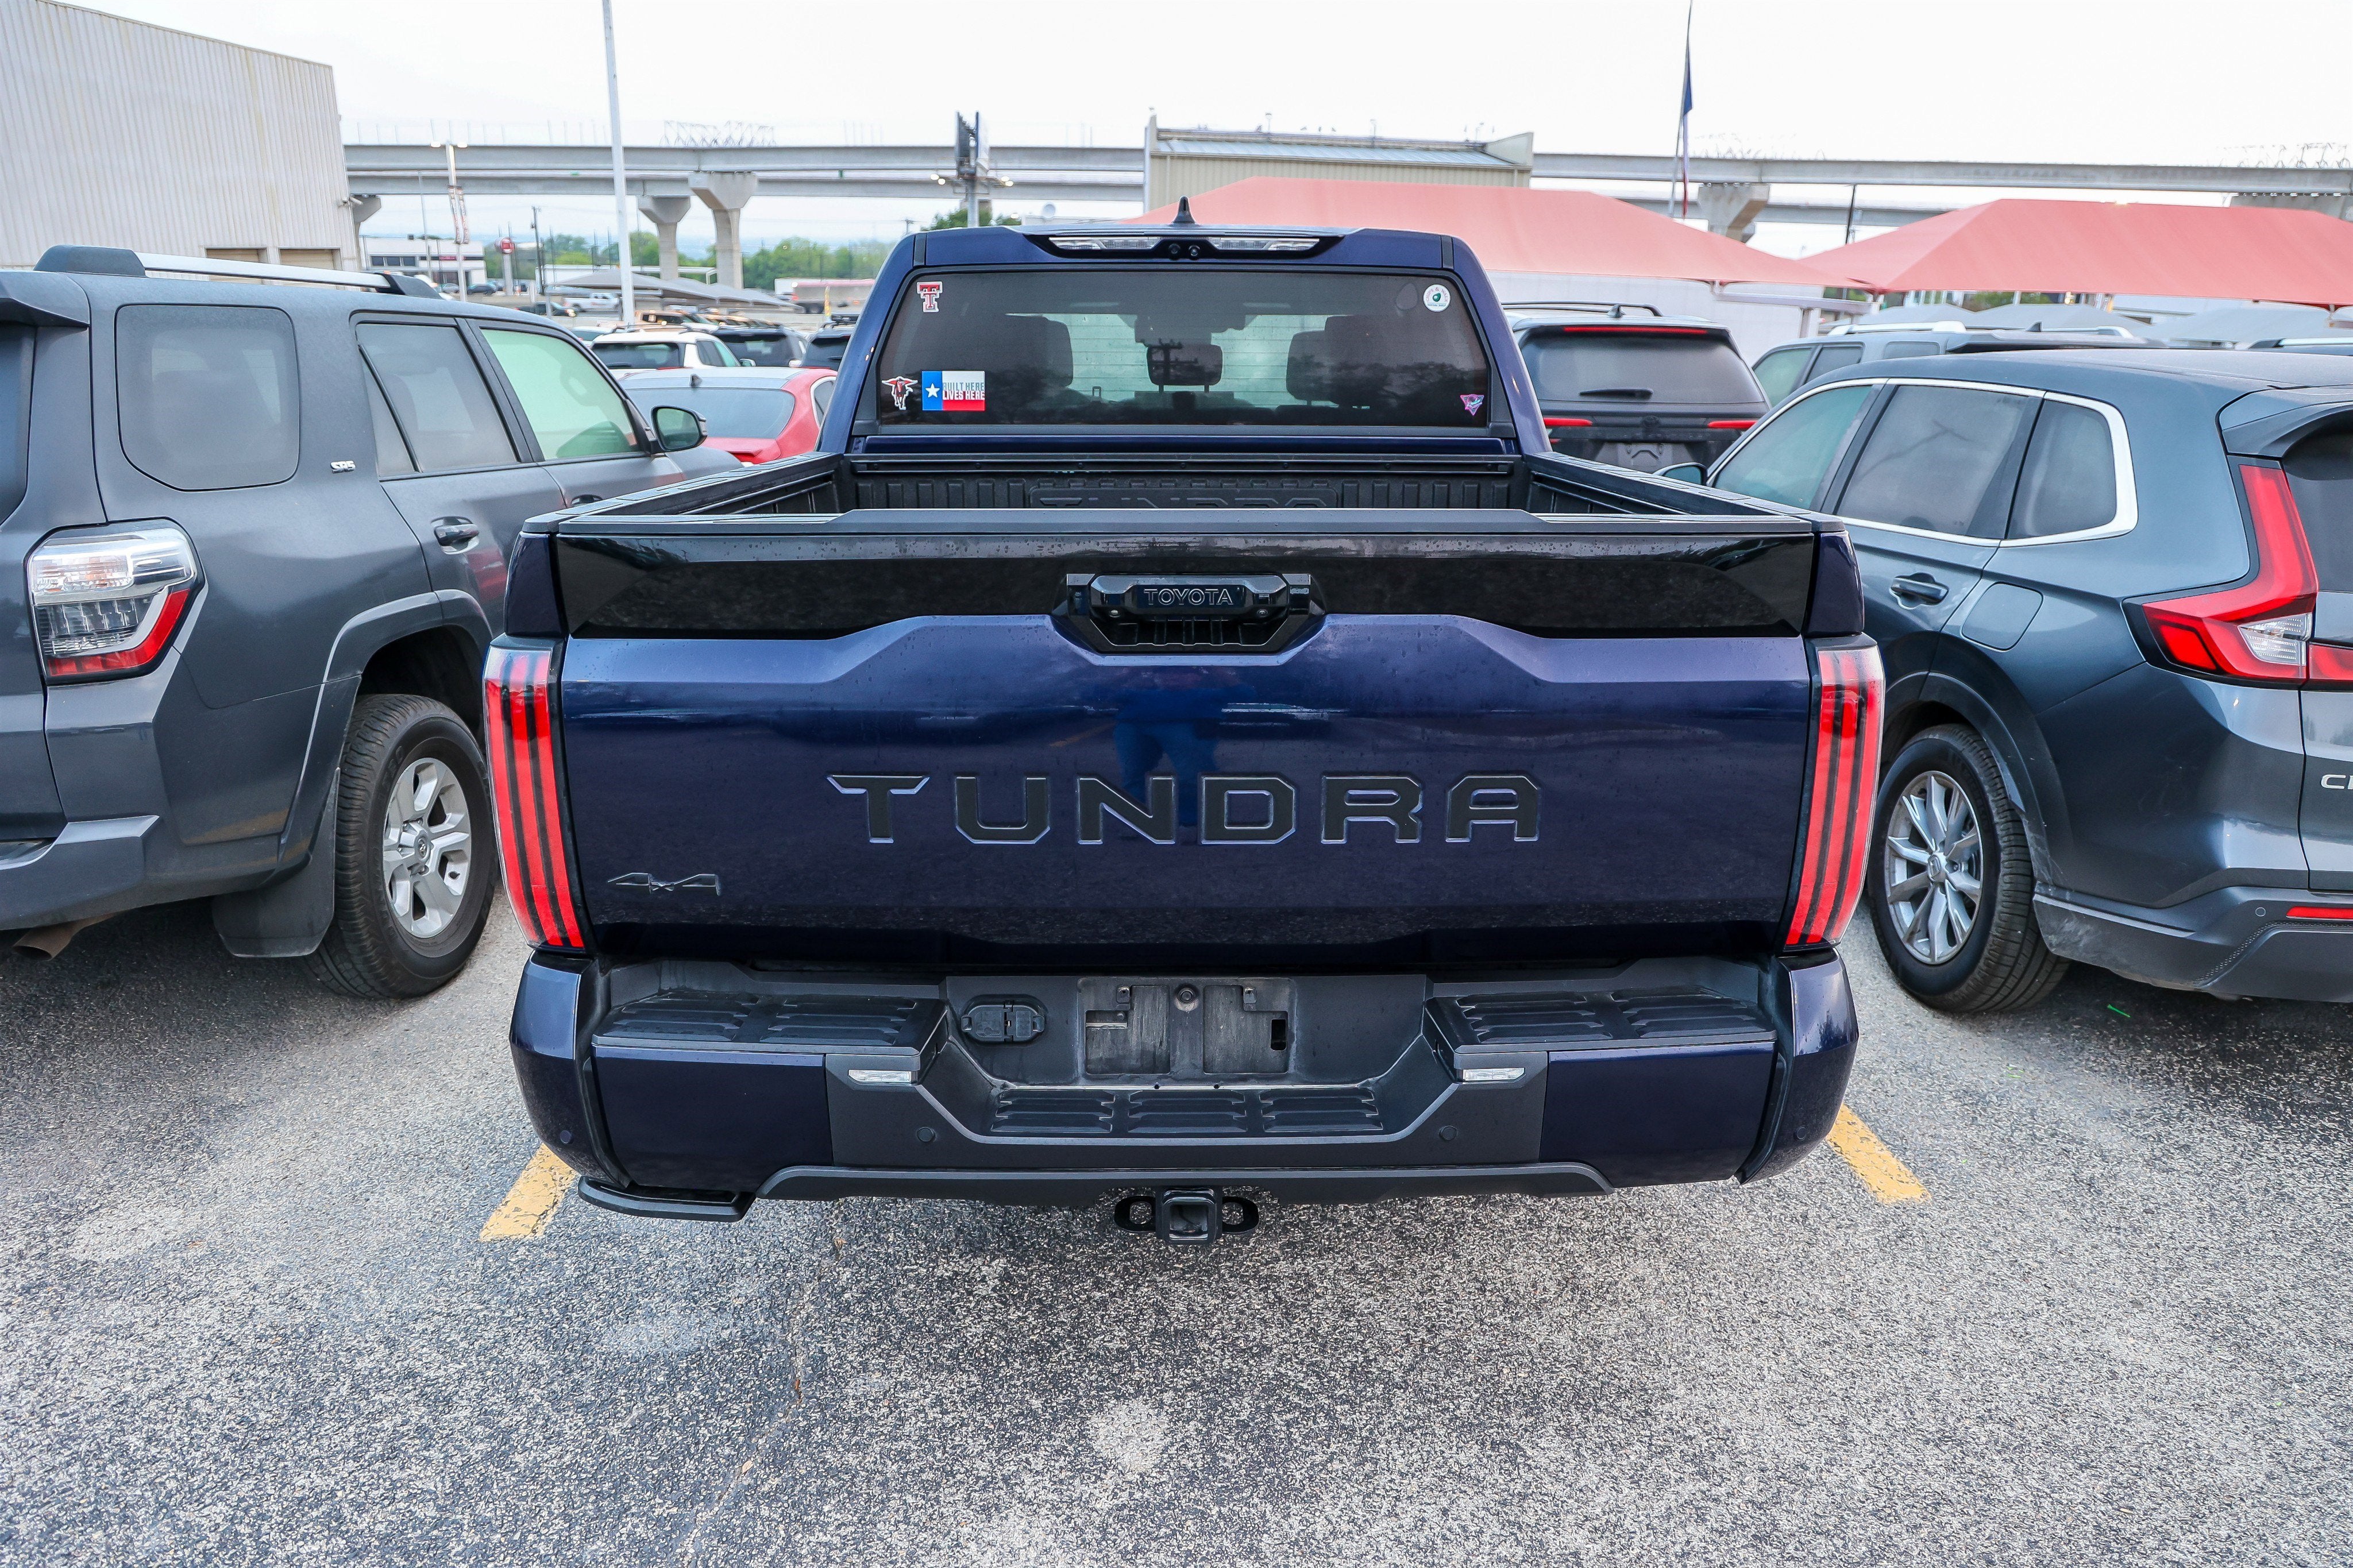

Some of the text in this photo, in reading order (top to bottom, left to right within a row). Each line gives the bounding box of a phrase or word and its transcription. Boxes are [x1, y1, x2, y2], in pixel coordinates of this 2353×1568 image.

[943, 382, 985, 391] BUILT HERE
[943, 391, 985, 400] LIVES HERE
[330, 460, 356, 473] SR5
[1143, 588, 1234, 605] TOYOTA
[2321, 774, 2353, 790] C
[826, 774, 1541, 845] TUNDRA
